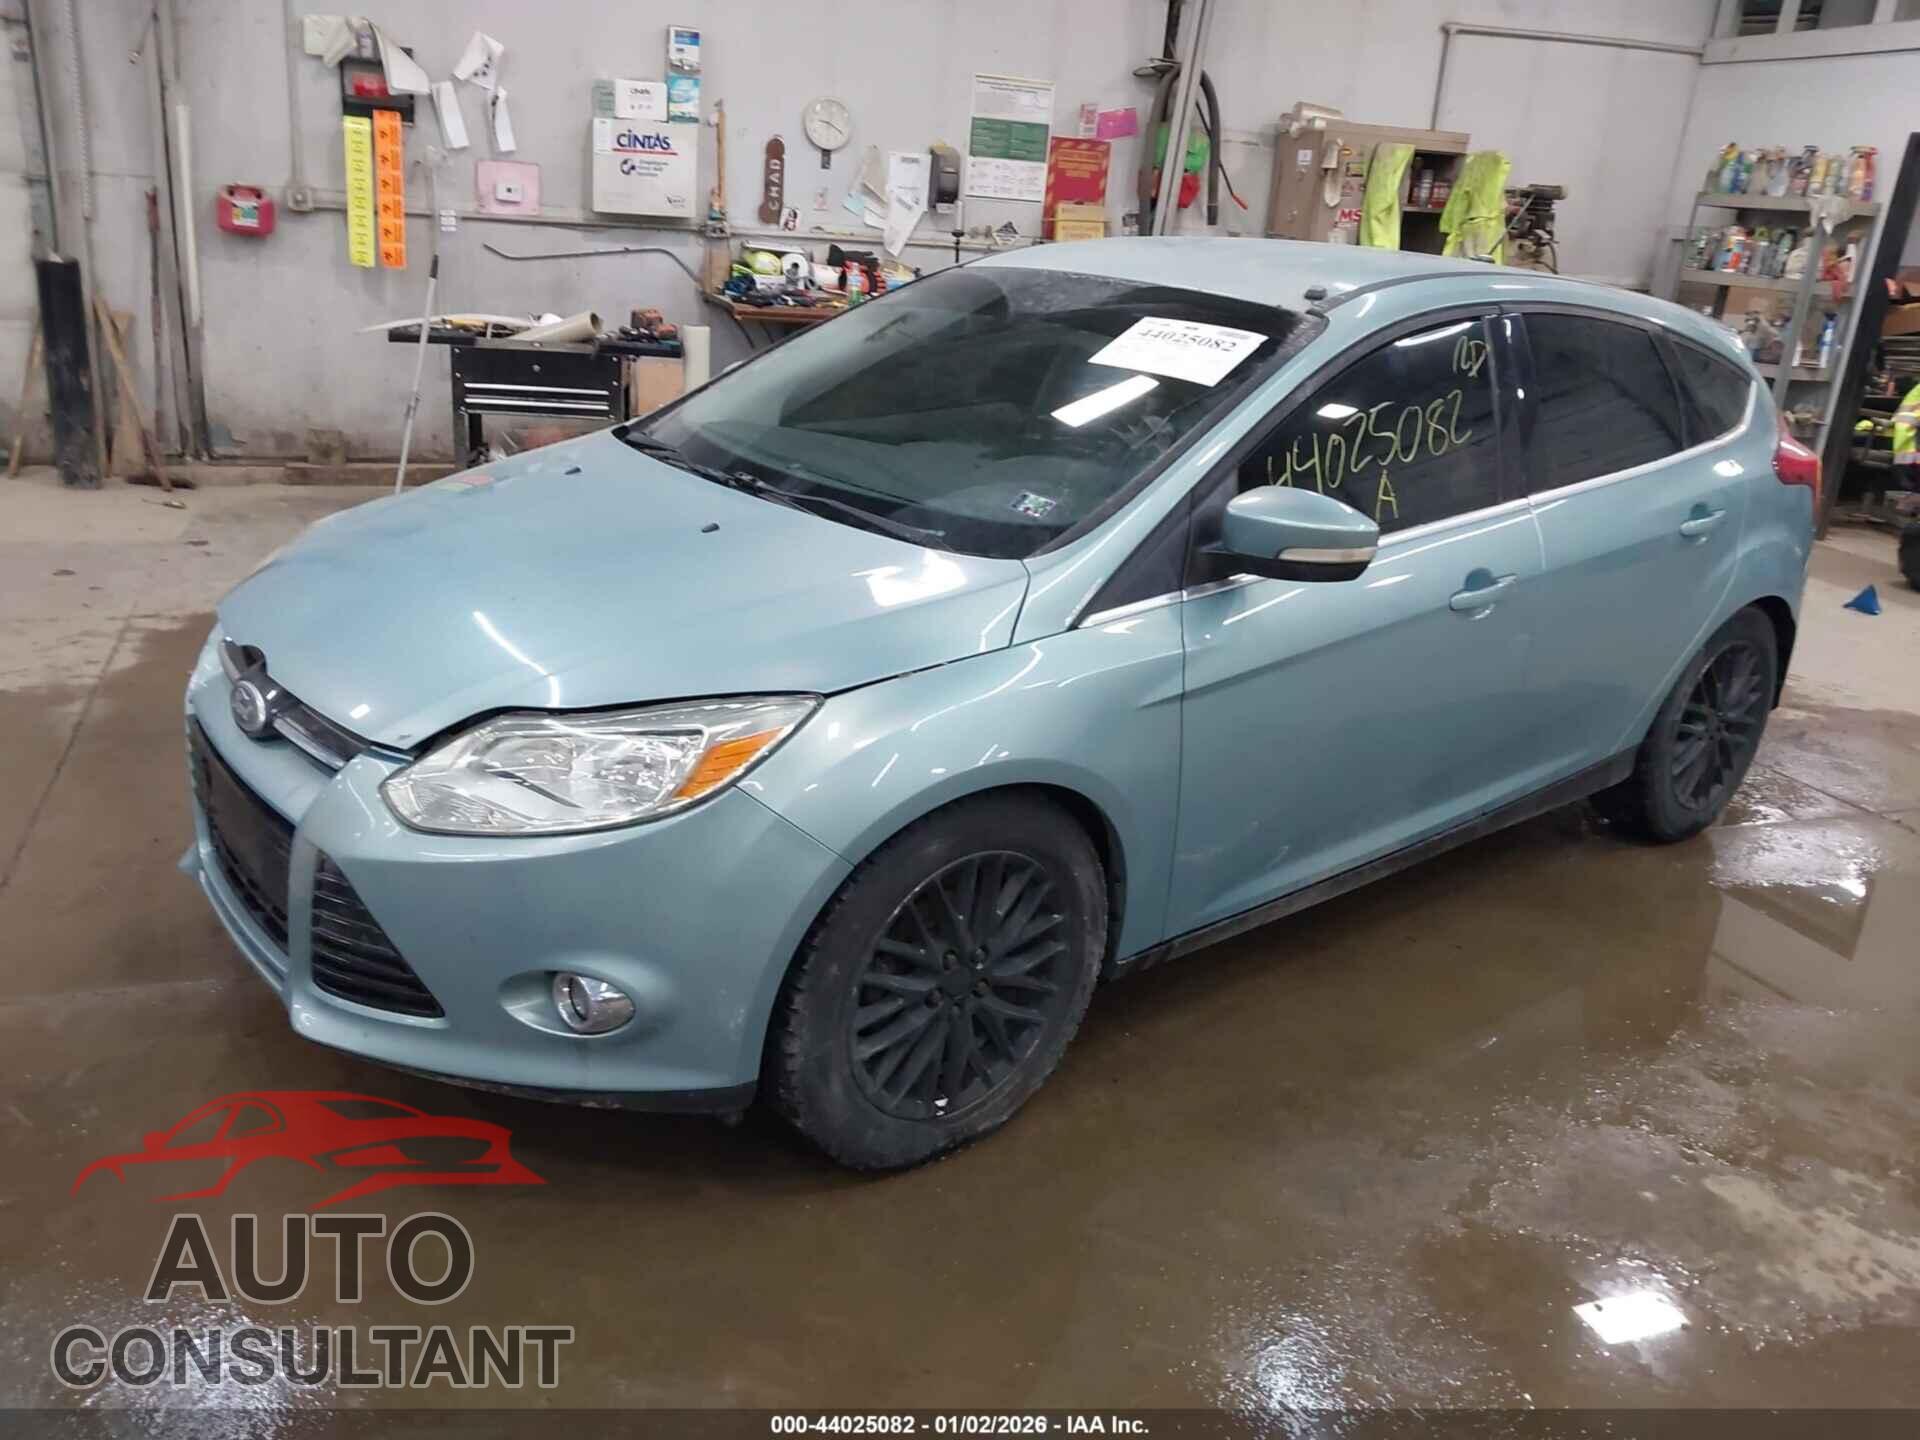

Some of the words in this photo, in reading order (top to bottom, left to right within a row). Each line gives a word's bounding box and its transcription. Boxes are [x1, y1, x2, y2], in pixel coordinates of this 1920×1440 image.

[616, 129, 671, 150] CINTAS
[767, 158, 782, 210] CHAD
[1137, 328, 1238, 353] 44025082
[1266, 388, 1473, 495] 44025082
[1375, 469, 1399, 523] A
